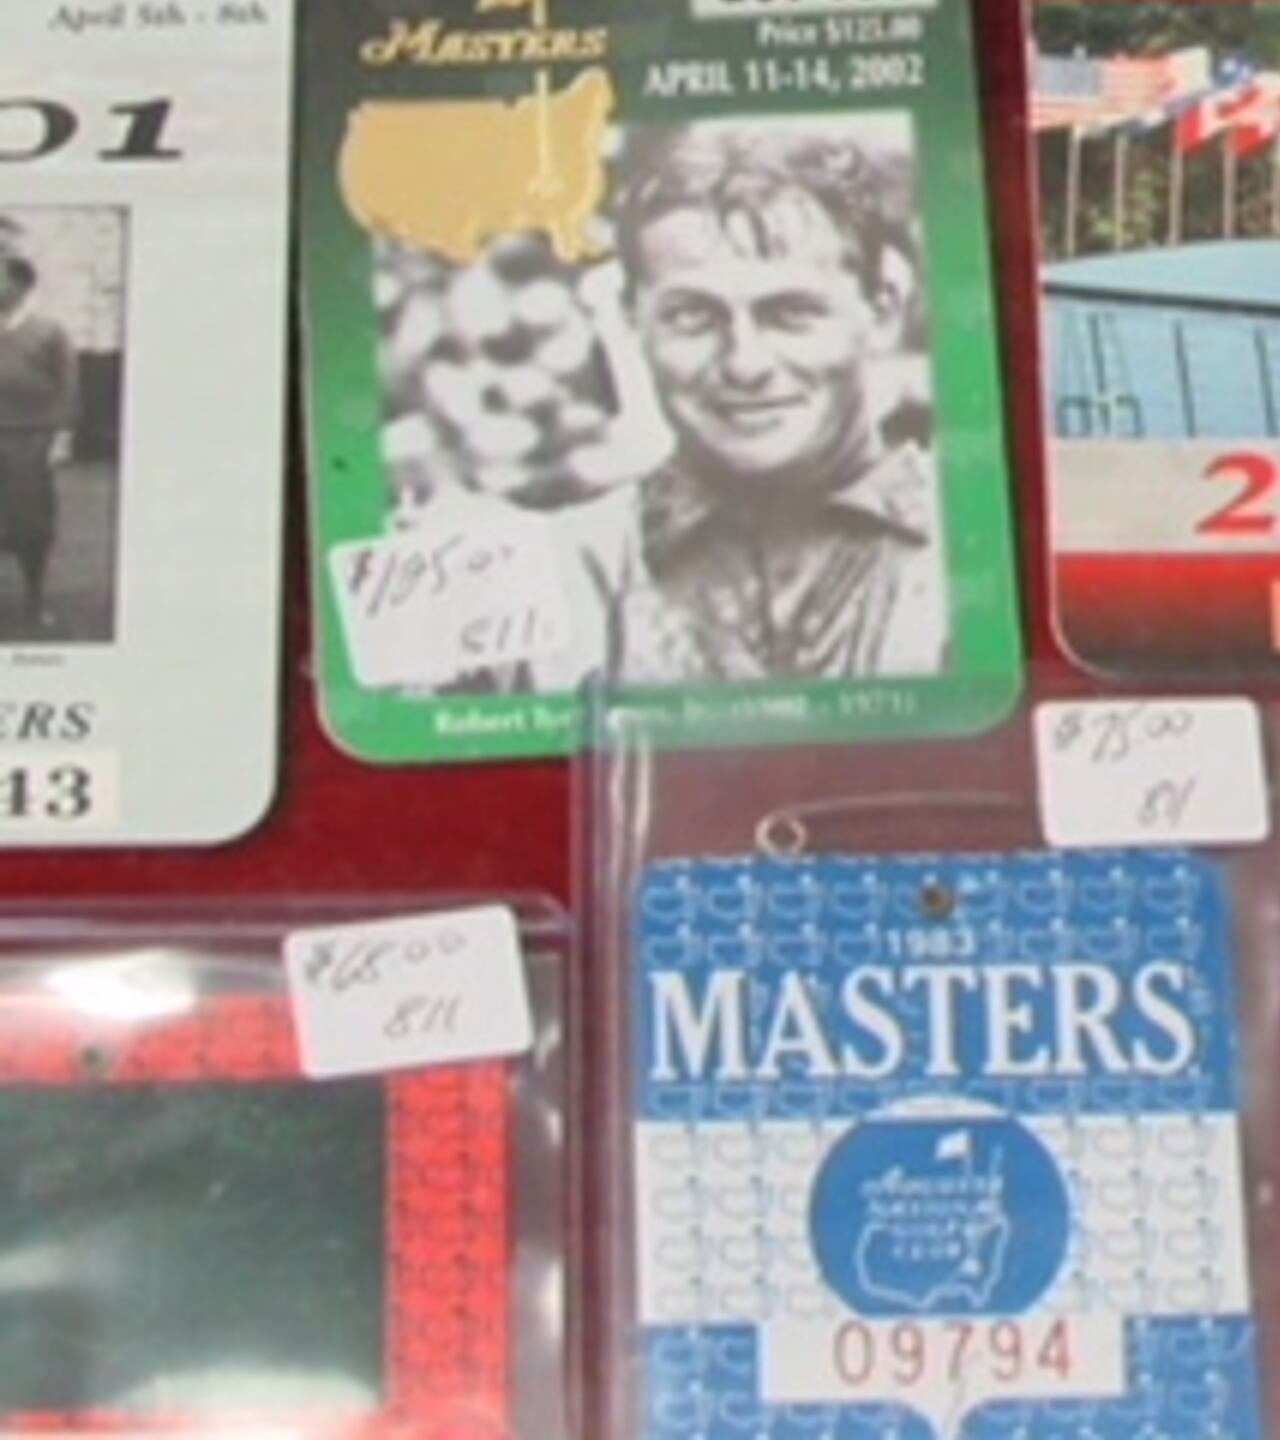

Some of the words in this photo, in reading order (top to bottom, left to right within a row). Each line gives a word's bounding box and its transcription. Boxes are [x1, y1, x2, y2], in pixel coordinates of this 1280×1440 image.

[757, 17, 818, 45] Price
[644, 62, 732, 95] APRIL
[851, 56, 924, 88] 2002
[649, 961, 1198, 1080] MASTERS
[833, 1321, 1074, 1386] 09794
